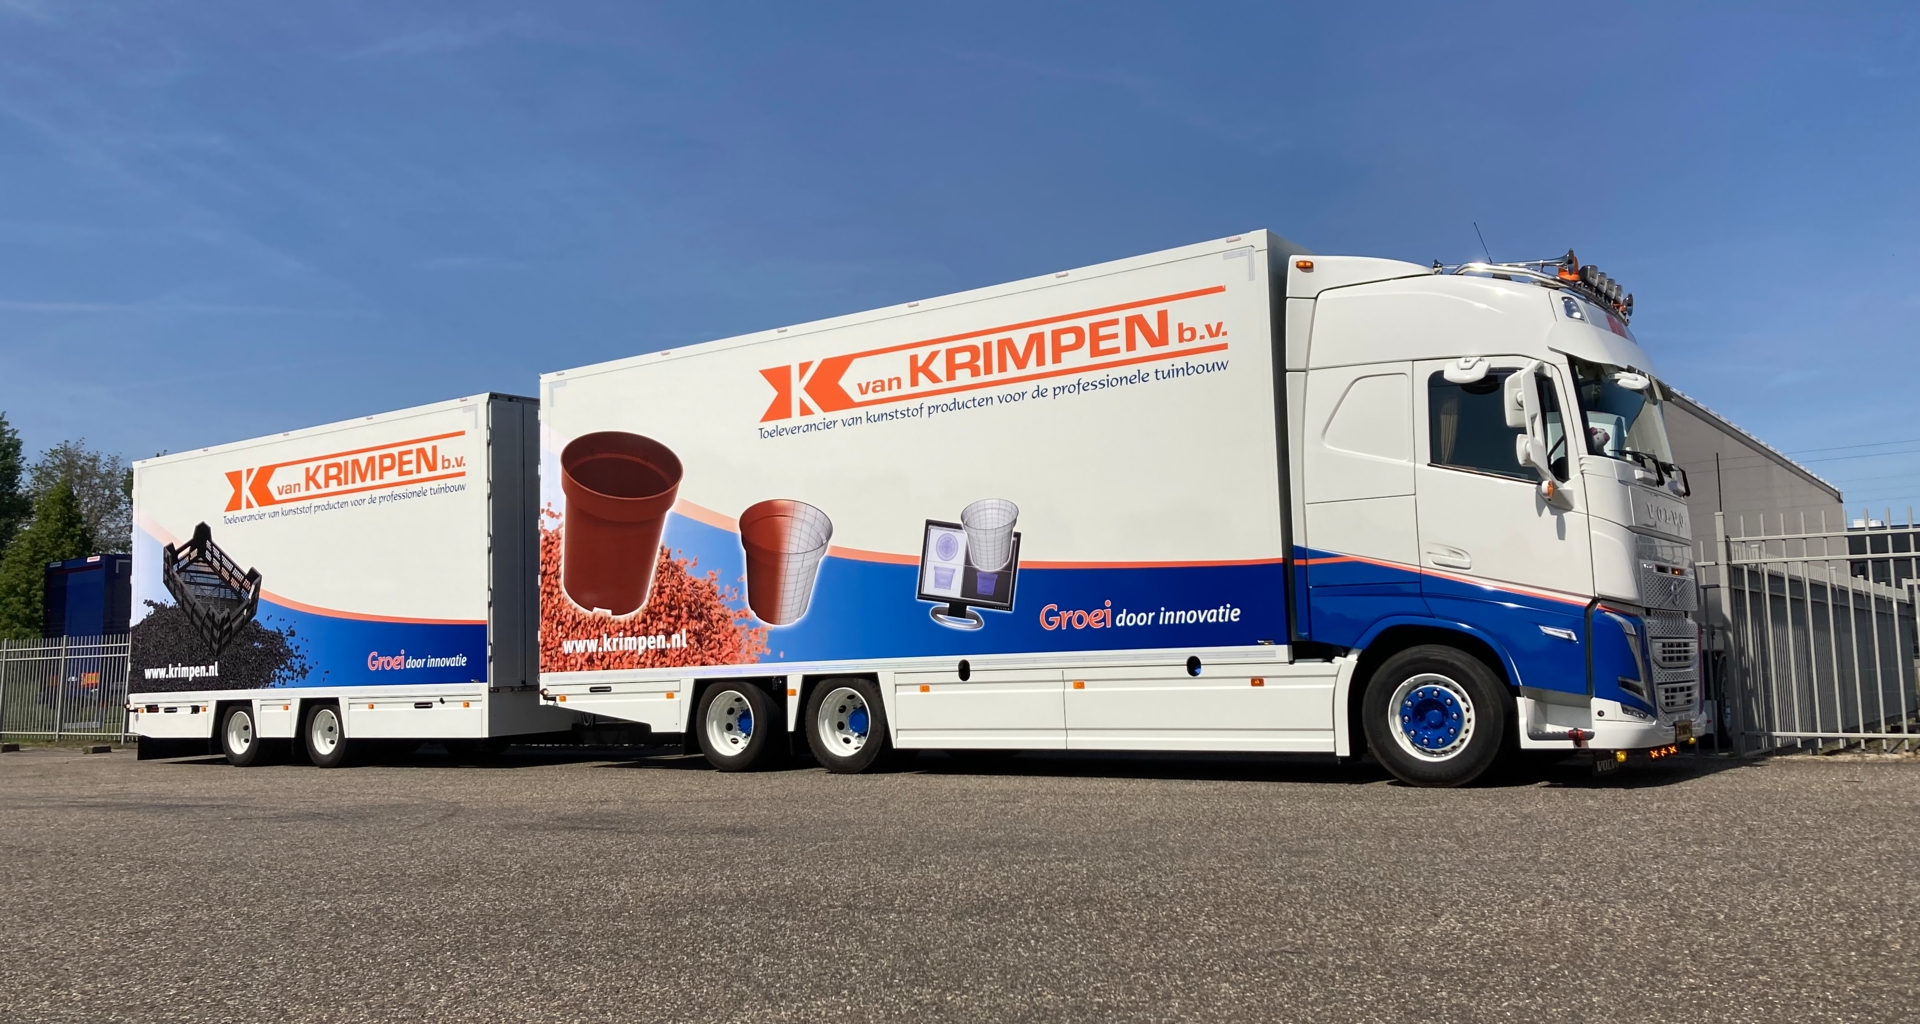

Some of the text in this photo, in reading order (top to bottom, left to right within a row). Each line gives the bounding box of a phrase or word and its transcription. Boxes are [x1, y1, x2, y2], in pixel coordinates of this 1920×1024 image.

[857, 309, 1228, 396] van KRIMPEN b.v.
[758, 359, 1230, 439] Toeleverancier van kunststof producten voor de professionele tuinbouw
[277, 445, 466, 496] van KRIMPEN b.v.
[223, 483, 467, 525] Toeleverancier van kunststof producten voor de professionele tuinbouw
[1645, 502, 1684, 528] VOLVO
[1039, 599, 1241, 631] Groei door innovatie
[563, 628, 688, 655] www.krimpen.nl
[144, 661, 219, 681] www.krimpen.nl
[367, 649, 467, 671] Groei door innovatie
